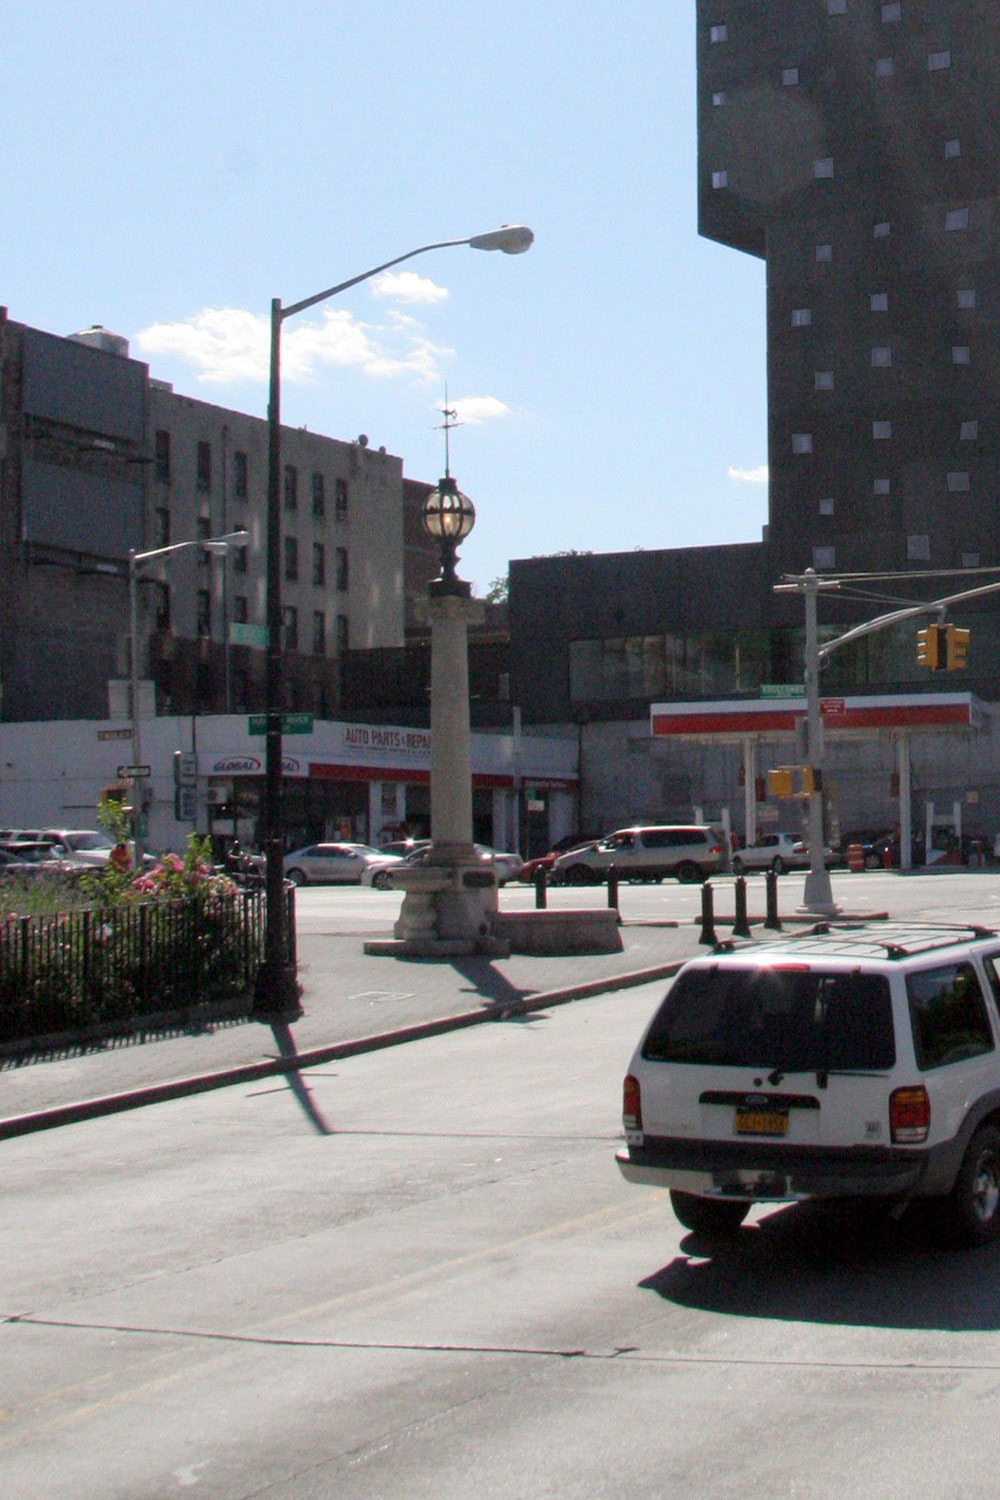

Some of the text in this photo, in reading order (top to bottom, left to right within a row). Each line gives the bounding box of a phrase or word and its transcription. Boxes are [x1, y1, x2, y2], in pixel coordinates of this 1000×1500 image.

[344, 728, 369, 744] AUTO
[371, 730, 400, 747] PARTS
[213, 761, 256, 772] GLOBAL
